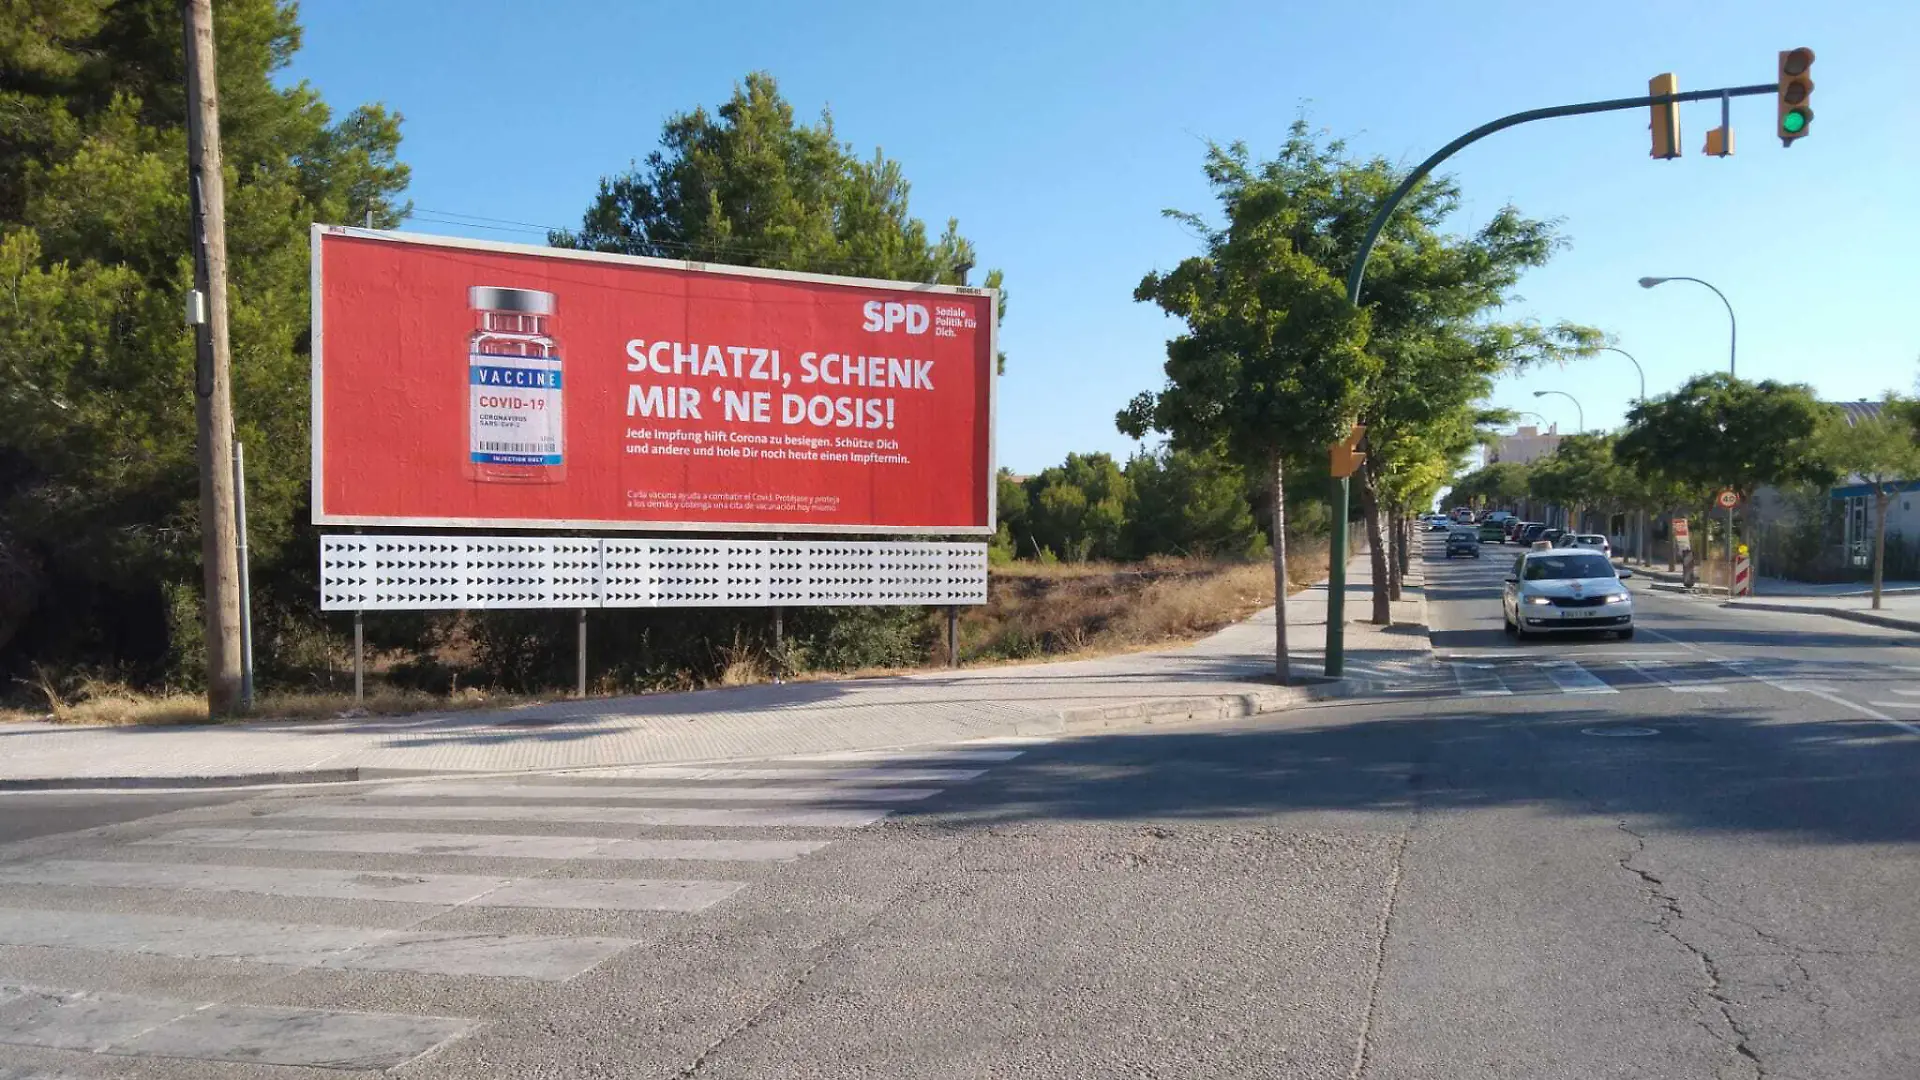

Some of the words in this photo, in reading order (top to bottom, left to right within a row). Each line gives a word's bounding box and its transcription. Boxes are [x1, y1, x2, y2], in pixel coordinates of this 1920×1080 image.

[862, 300, 930, 335] SPD
[935, 306, 966, 317] Soziale
[935, 317, 962, 328] Politik
[964, 318, 977, 329] für
[935, 327, 957, 337] Dich.
[625, 338, 792, 389] SCHATZI,
[799, 351, 935, 391] SCHENK
[480, 368, 556, 386] VACCINE
[479, 396, 545, 410] COVID-19
[626, 384, 703, 420] MIR
[781, 392, 895, 430] DOSIS!
[479, 414, 527, 422] CORONAVIRUS
[625, 427, 652, 440] Jede
[654, 428, 702, 444] Impfung
[704, 430, 728, 442] hilft
[729, 431, 768, 444] Corona
[769, 435, 781, 445] zu
[785, 434, 833, 449] besiegen.
[835, 436, 874, 449] Schütze
[876, 438, 899, 450] Dich
[625, 443, 649, 454] und
[651, 444, 690, 456] andere
[693, 445, 714, 456] und
[716, 446, 740, 457] hole
[742, 447, 758, 458] Dir
[760, 448, 786, 459] noch
[788, 449, 818, 460] heute
[820, 450, 848, 462] einen
[850, 451, 910, 465] Impftermin.
